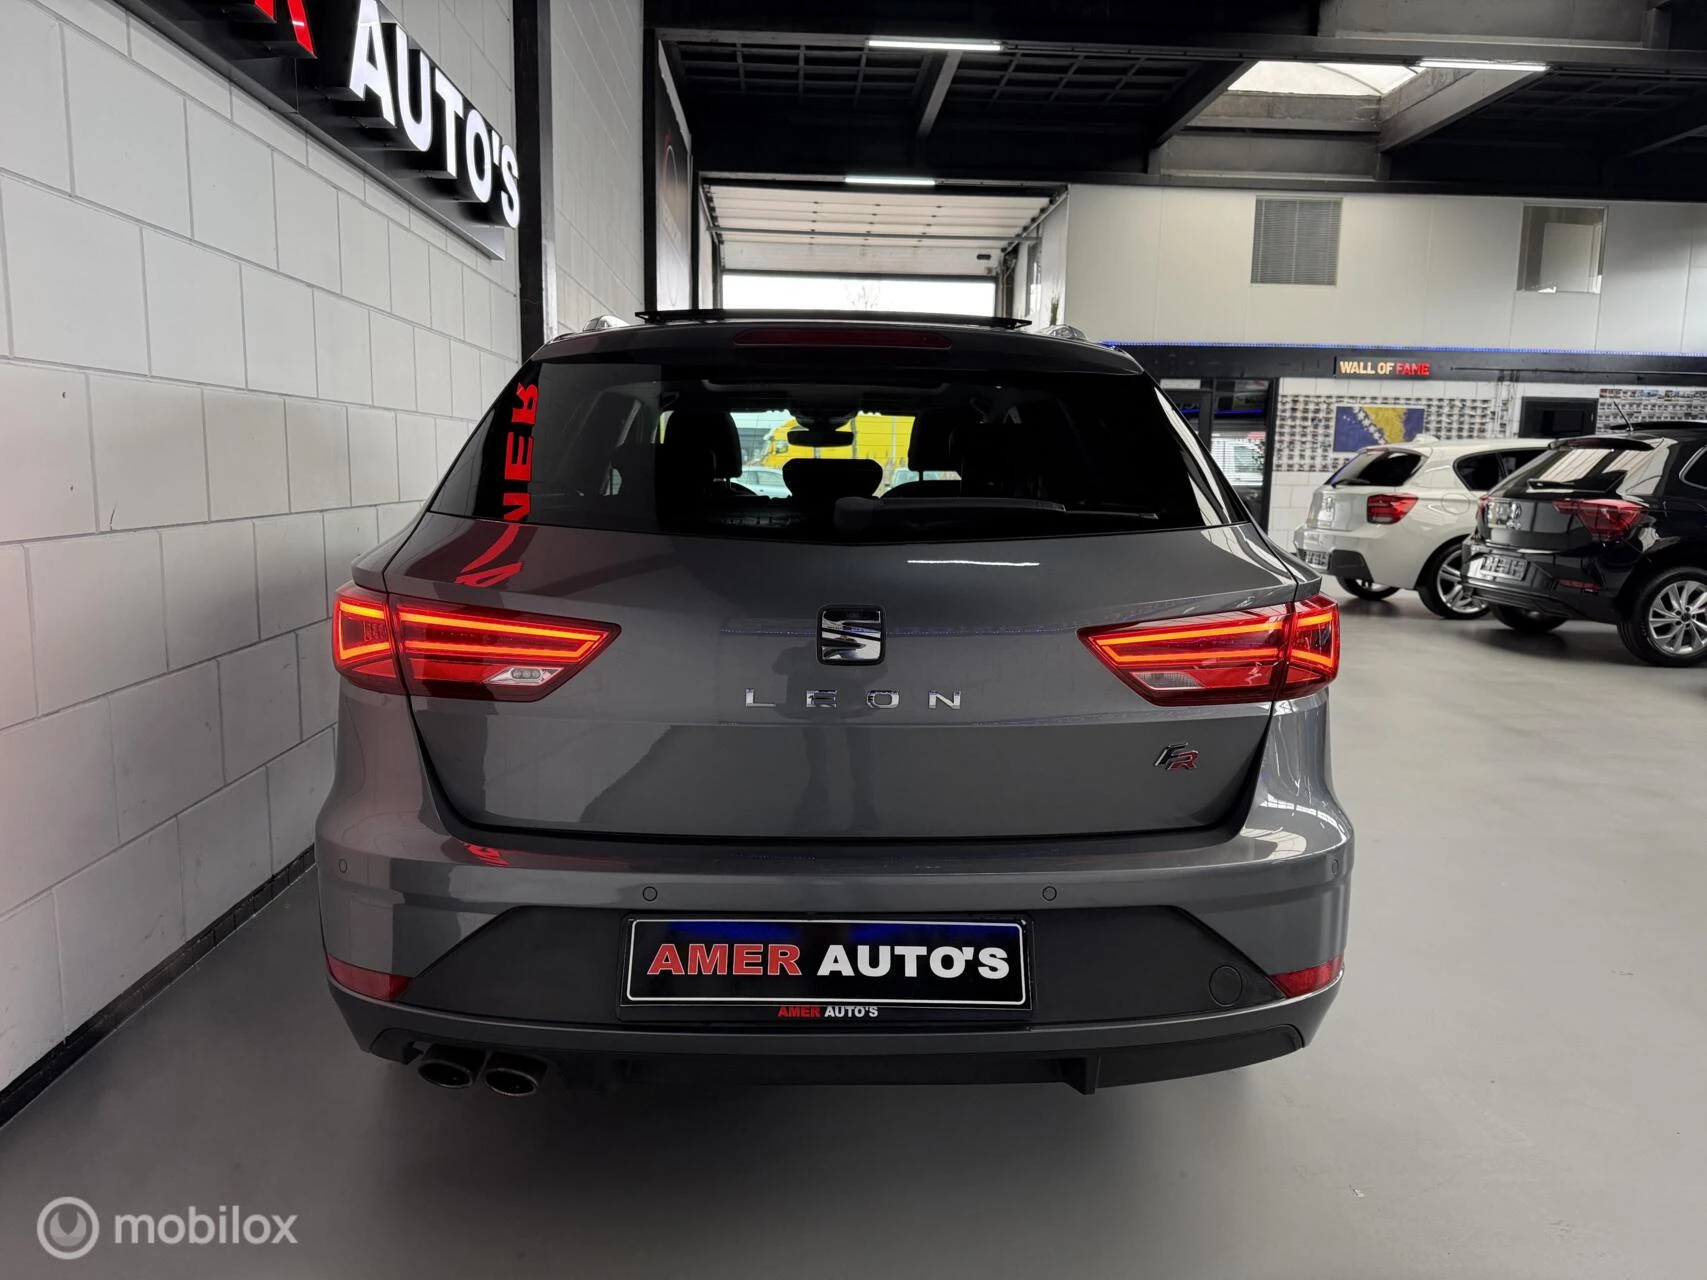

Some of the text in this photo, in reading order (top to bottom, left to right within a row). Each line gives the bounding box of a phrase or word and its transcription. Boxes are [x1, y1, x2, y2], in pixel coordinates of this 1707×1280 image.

[350, 0, 520, 228] AUTO'S
[1340, 361, 1431, 376] WALL OF FAME
[746, 688, 961, 710] LEON
[1155, 742, 1199, 770] FR
[647, 943, 1010, 980] AMER AUTO'S
[778, 1005, 879, 1018] AMER AUTO'S
